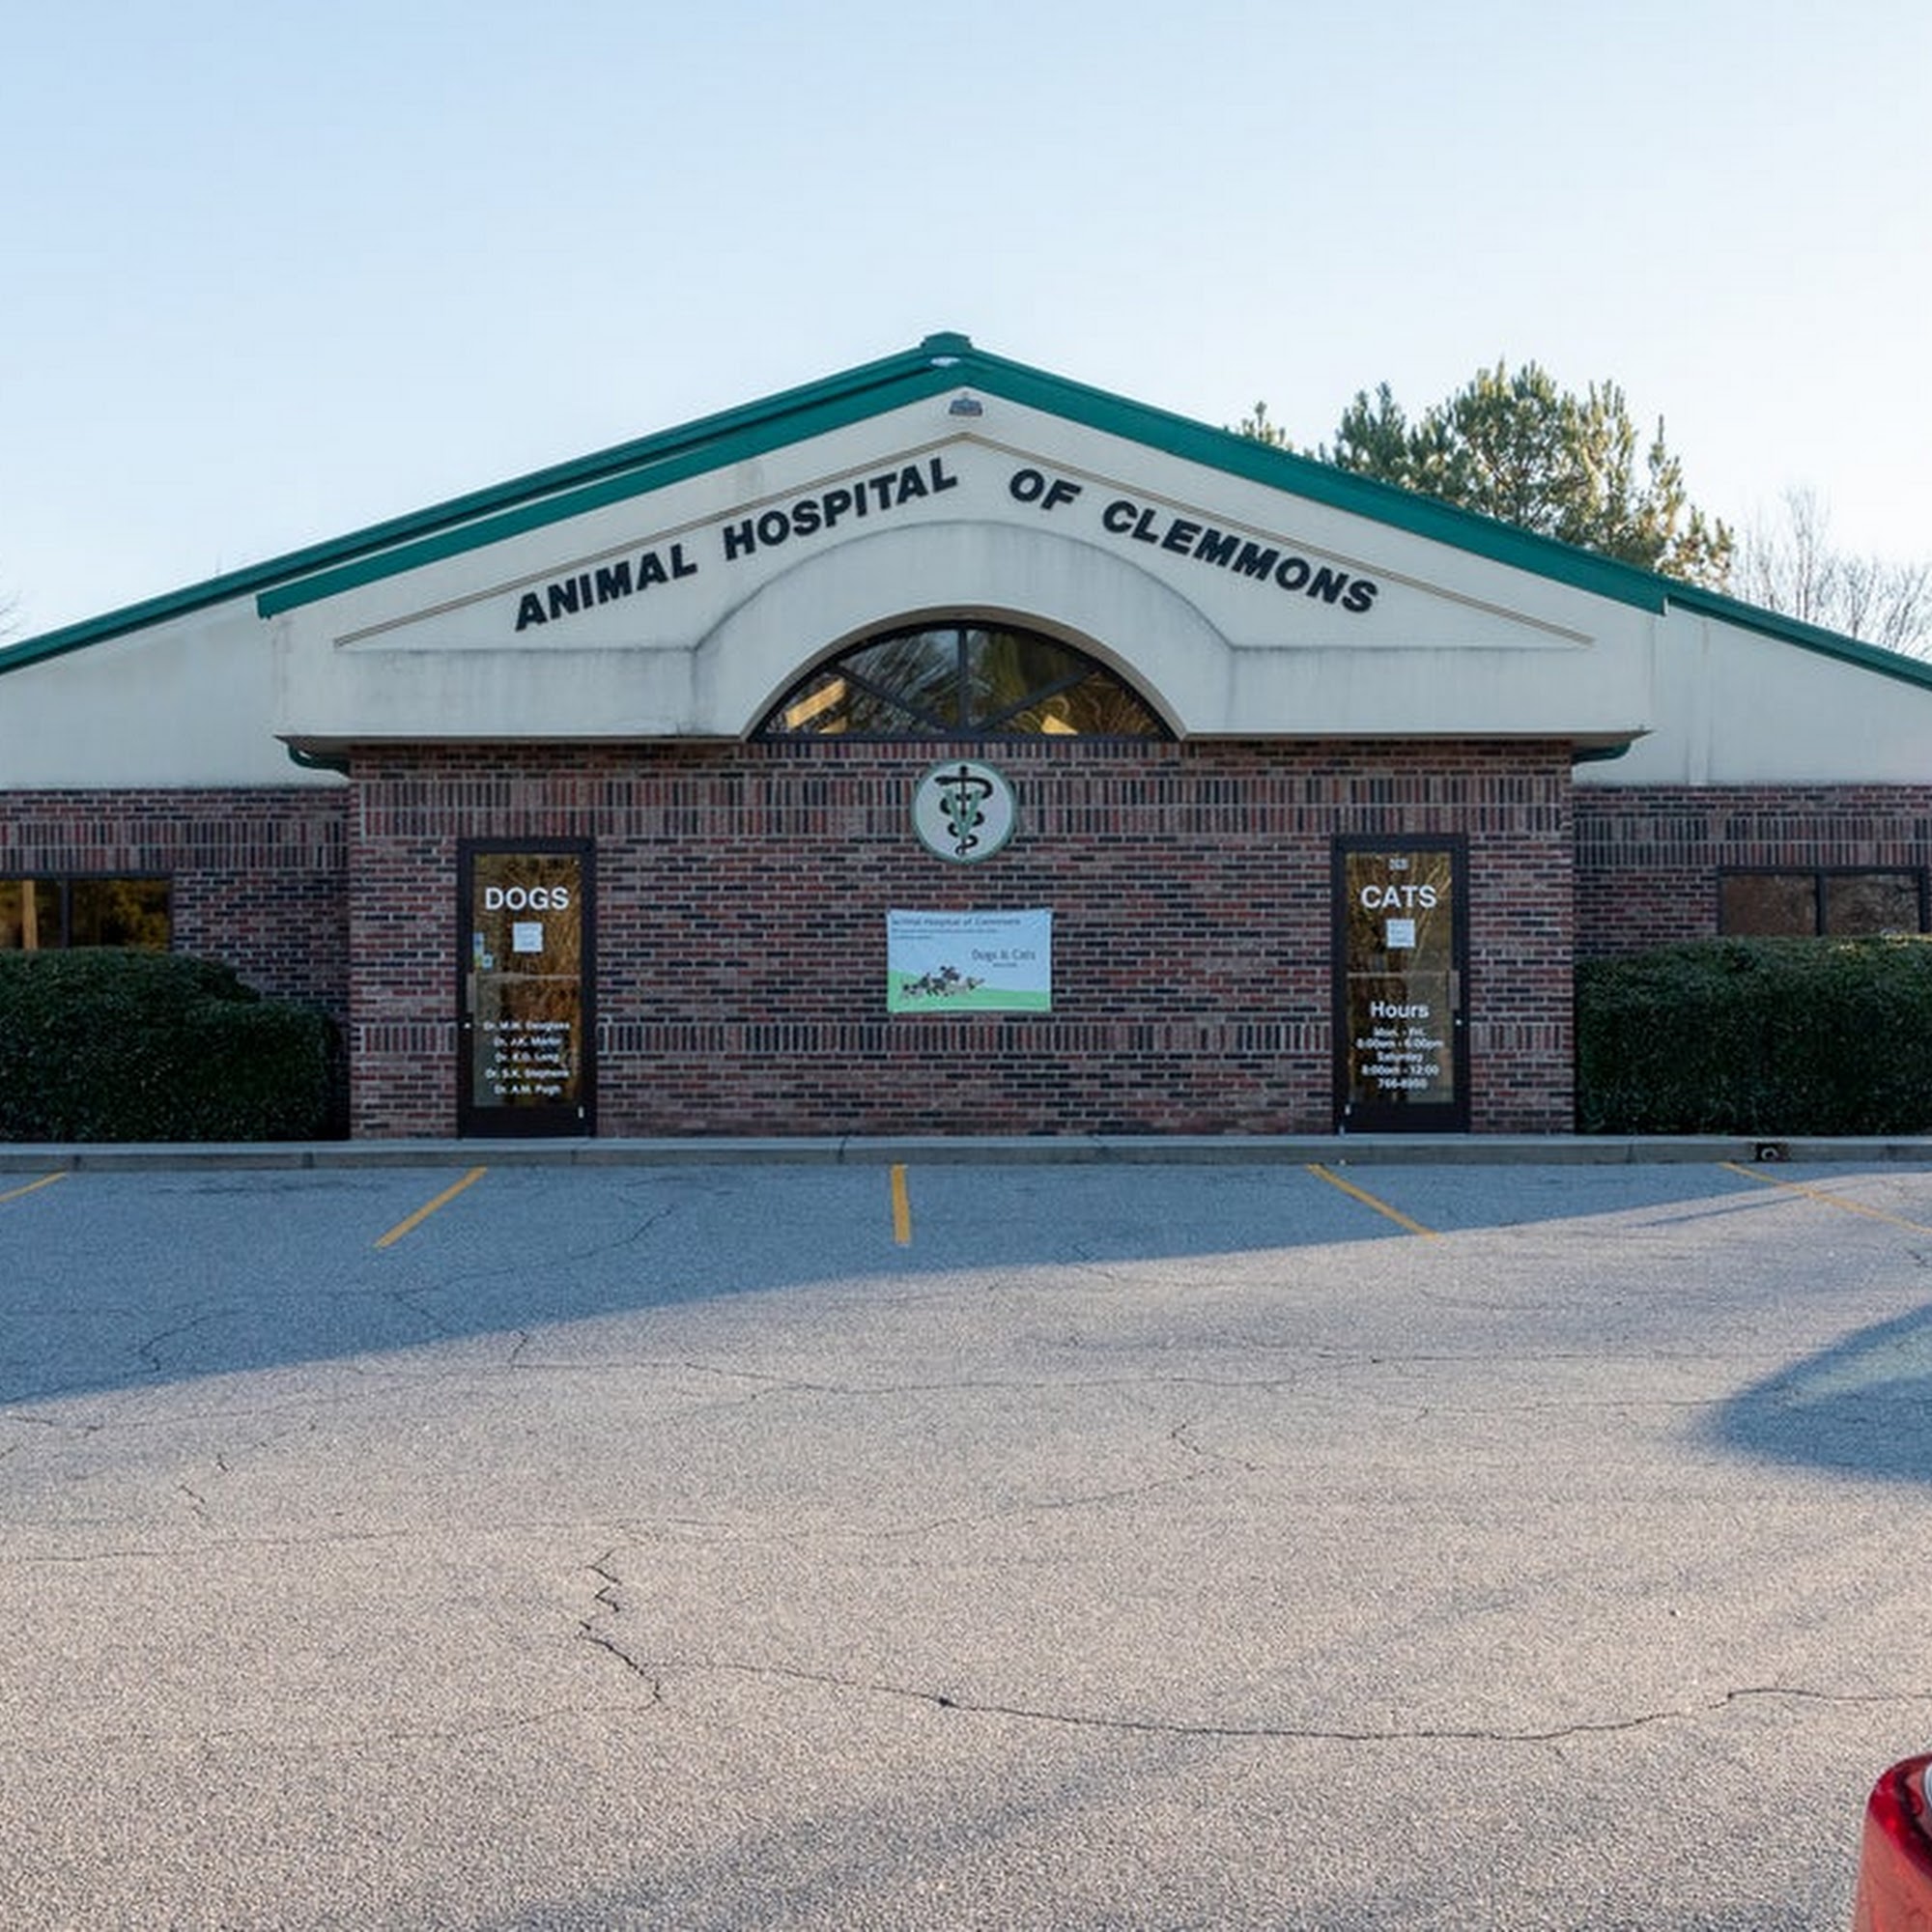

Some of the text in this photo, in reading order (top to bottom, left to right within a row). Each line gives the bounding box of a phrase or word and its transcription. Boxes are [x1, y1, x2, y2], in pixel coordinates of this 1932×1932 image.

[515, 457, 1378, 632] ANIMAL HOSPITAL OF CLEMMONS
[485, 887, 569, 910] DOGS
[1360, 885, 1437, 908] CATS
[1011, 949, 1036, 960] Cats
[1371, 1001, 1430, 1018] Hours
[1377, 1051, 1423, 1063] Saturday
